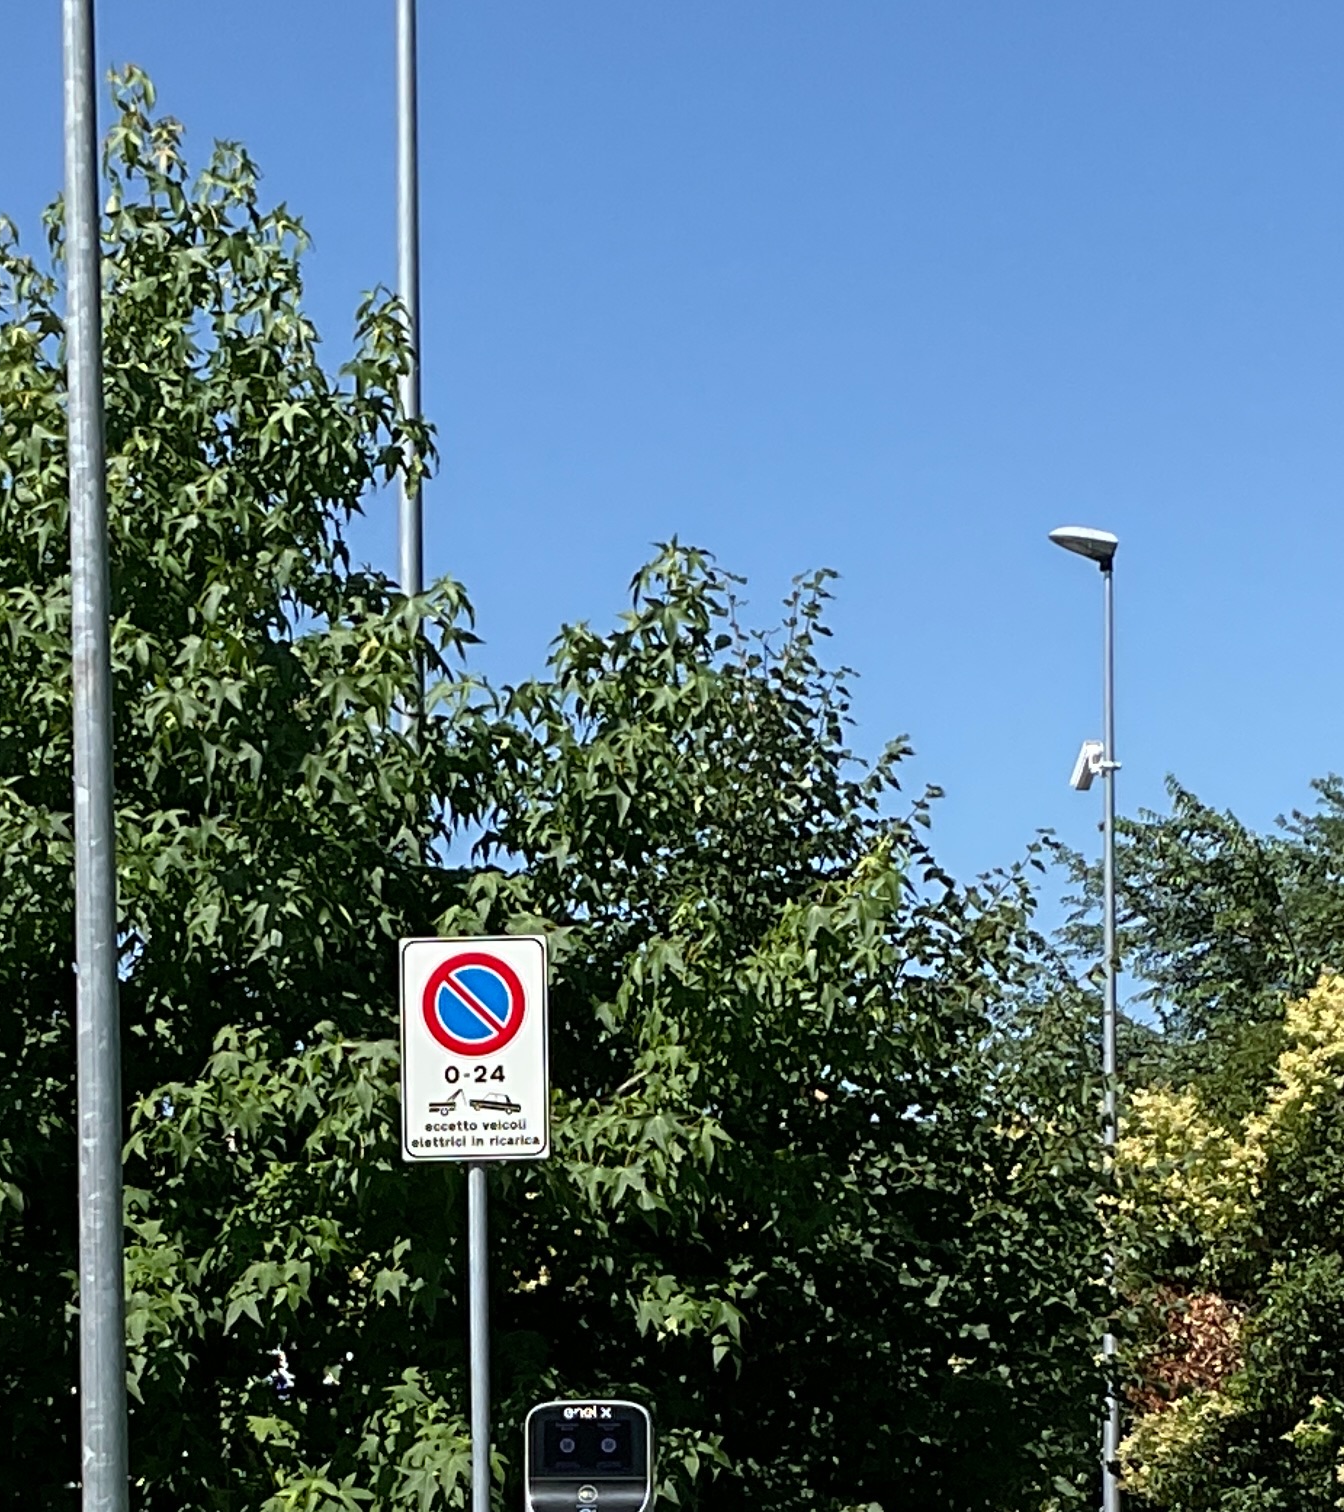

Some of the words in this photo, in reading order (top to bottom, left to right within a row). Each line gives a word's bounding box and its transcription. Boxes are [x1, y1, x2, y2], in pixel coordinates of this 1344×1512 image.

[444, 1065, 505, 1084] 0-24
[425, 1121, 477, 1132] eccetto
[482, 1119, 527, 1131] veicoli
[411, 1136, 466, 1147] elettrici
[471, 1135, 484, 1147] in
[489, 1134, 541, 1147] ricarica
[563, 1405, 597, 1419] enel
